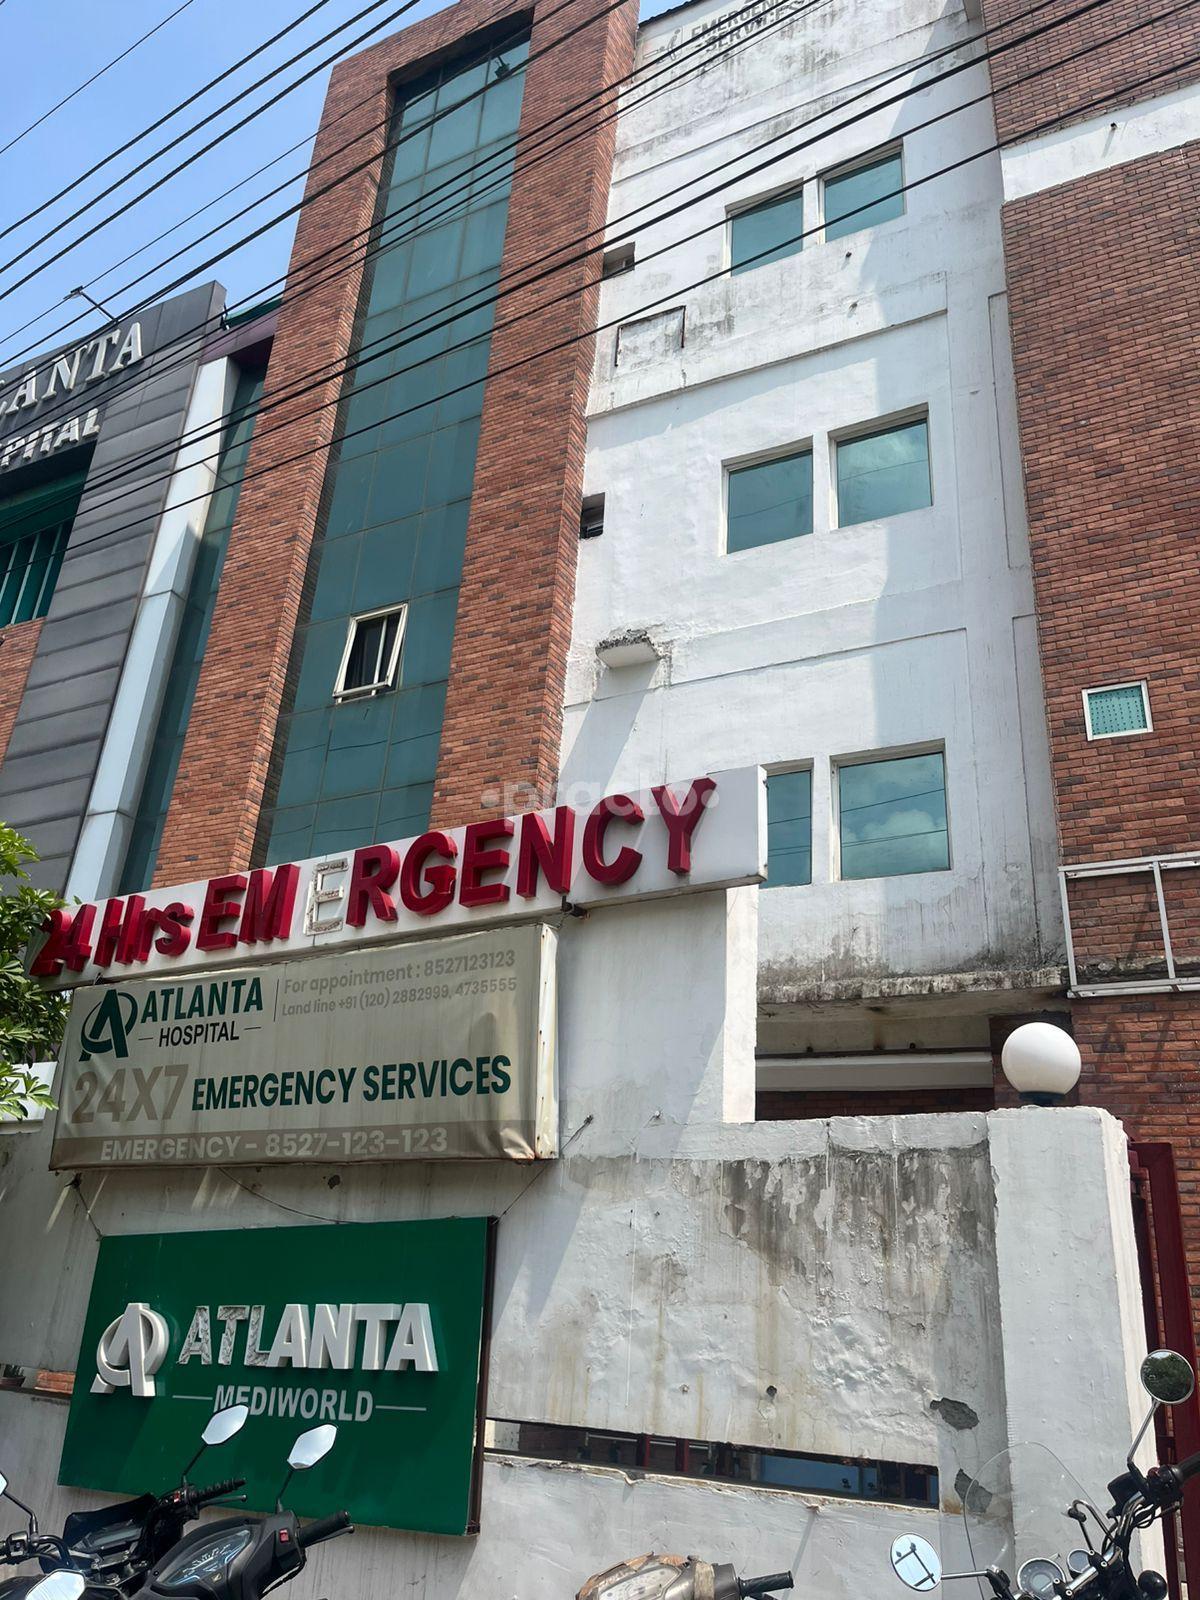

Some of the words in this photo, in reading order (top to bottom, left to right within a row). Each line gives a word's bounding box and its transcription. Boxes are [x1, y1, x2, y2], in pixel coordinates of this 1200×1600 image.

[0, 322, 144, 416] ANTA
[196, 777, 717, 951] EMERGENCY
[284, 979, 309, 994] For
[310, 965, 413, 994] appointment
[424, 949, 516, 977] 8527123123
[140, 977, 263, 1024] ATLANTA
[282, 1000, 311, 1016] Land
[313, 998, 336, 1013] line
[338, 995, 357, 1009] +91
[360, 987, 389, 1011] (120)
[455, 976, 518, 997] 4735555
[158, 1021, 240, 1047] HOSPITAL
[71, 1064, 189, 1124] 24X7
[191, 1067, 357, 1111] EMERGENCY
[362, 1055, 512, 1101] SERVICES
[101, 1135, 242, 1161] EMERGENCY
[264, 1127, 449, 1157] 8527-123-123
[175, 1303, 439, 1372] ATLANTA
[213, 1385, 374, 1422] MEDIWORLD
